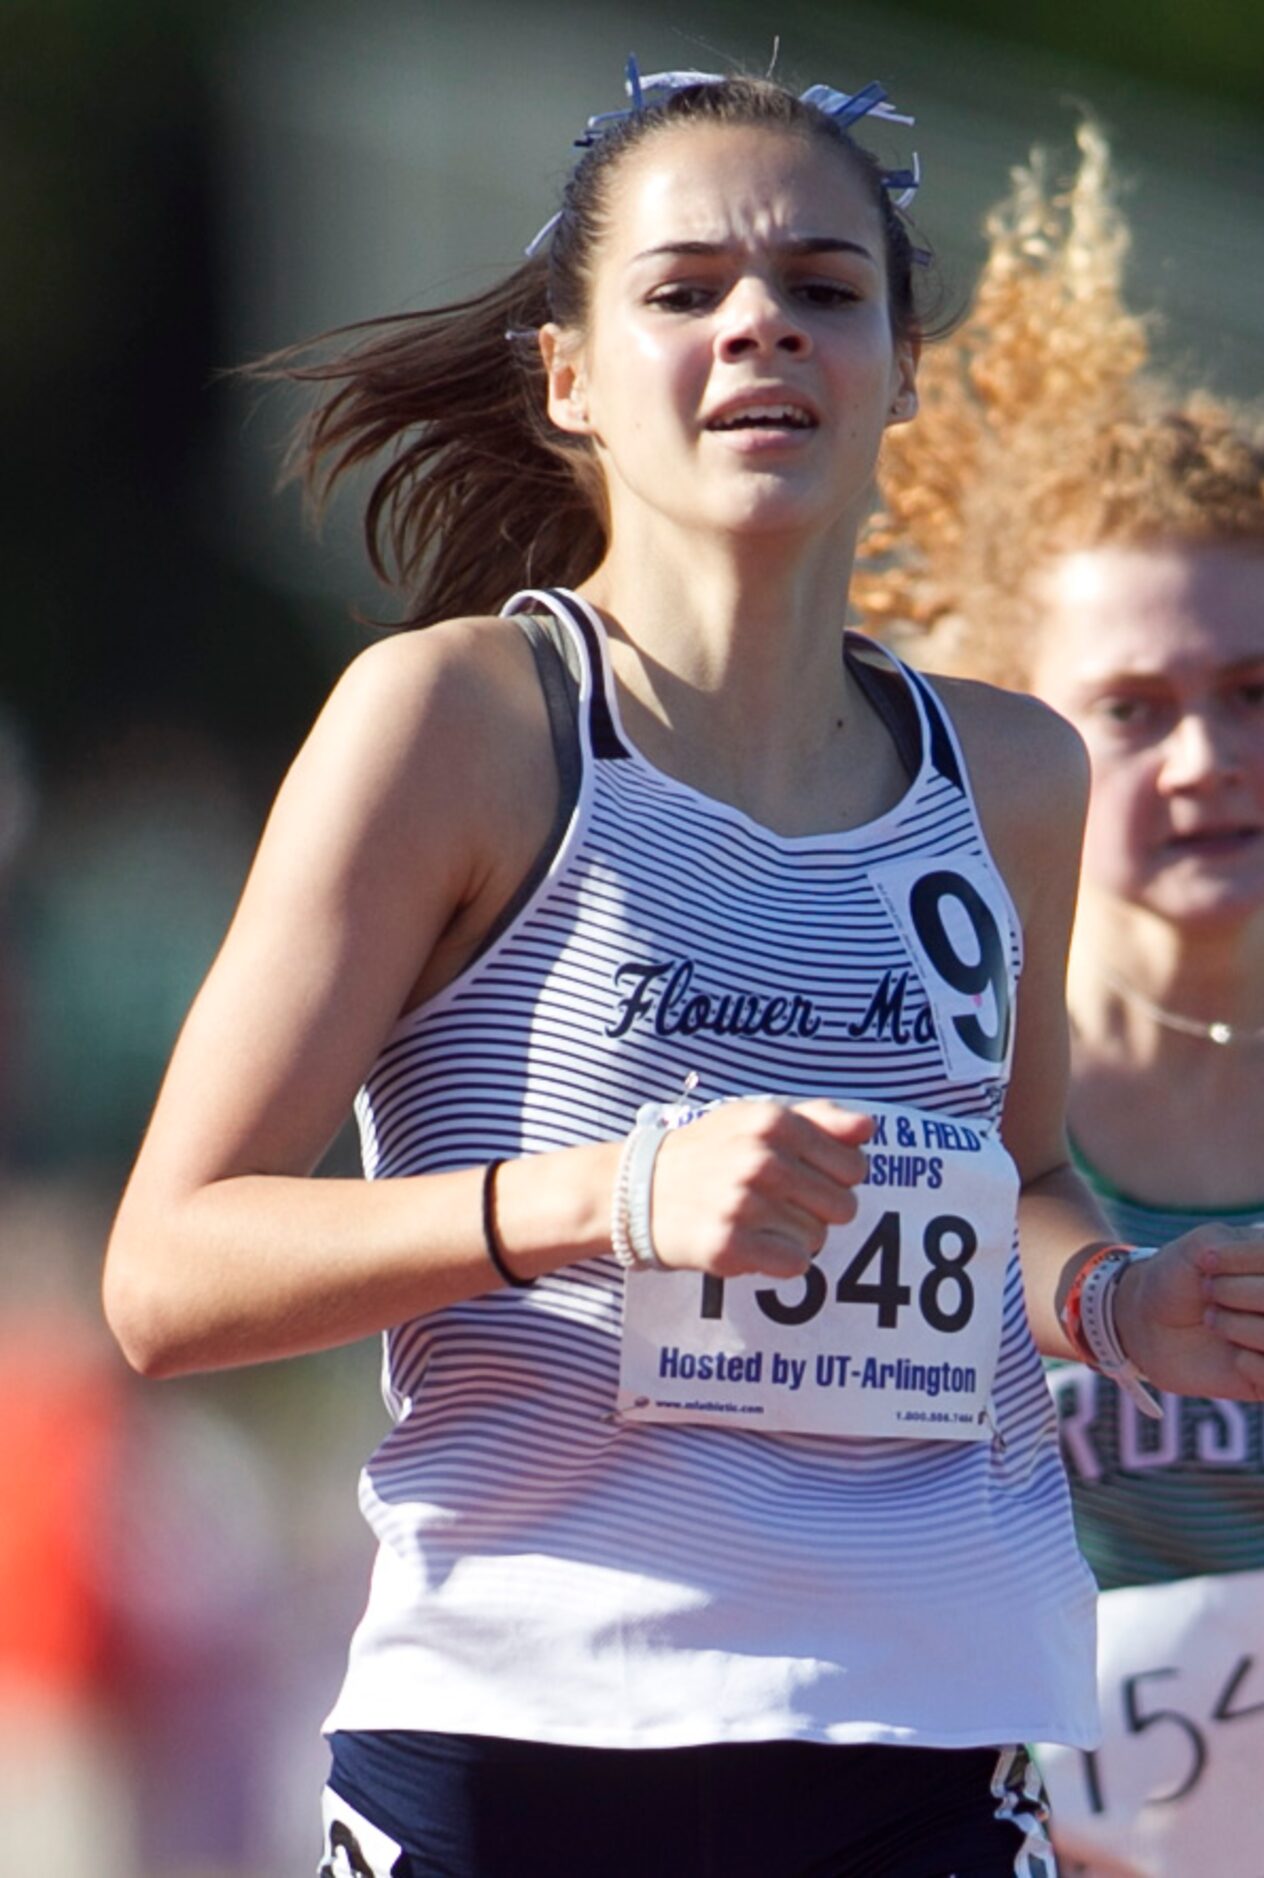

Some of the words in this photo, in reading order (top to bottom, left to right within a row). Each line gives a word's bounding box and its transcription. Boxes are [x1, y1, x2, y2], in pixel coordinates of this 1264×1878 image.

[605, 958, 821, 1039] Flower
[910, 869, 1010, 1063] 9
[896, 1115, 917, 1148] &
[921, 1118, 982, 1153] FIELD
[658, 1346, 763, 1383] Hosted
[771, 1352, 807, 1391] by
[815, 1354, 977, 1398] UT-Arlington
